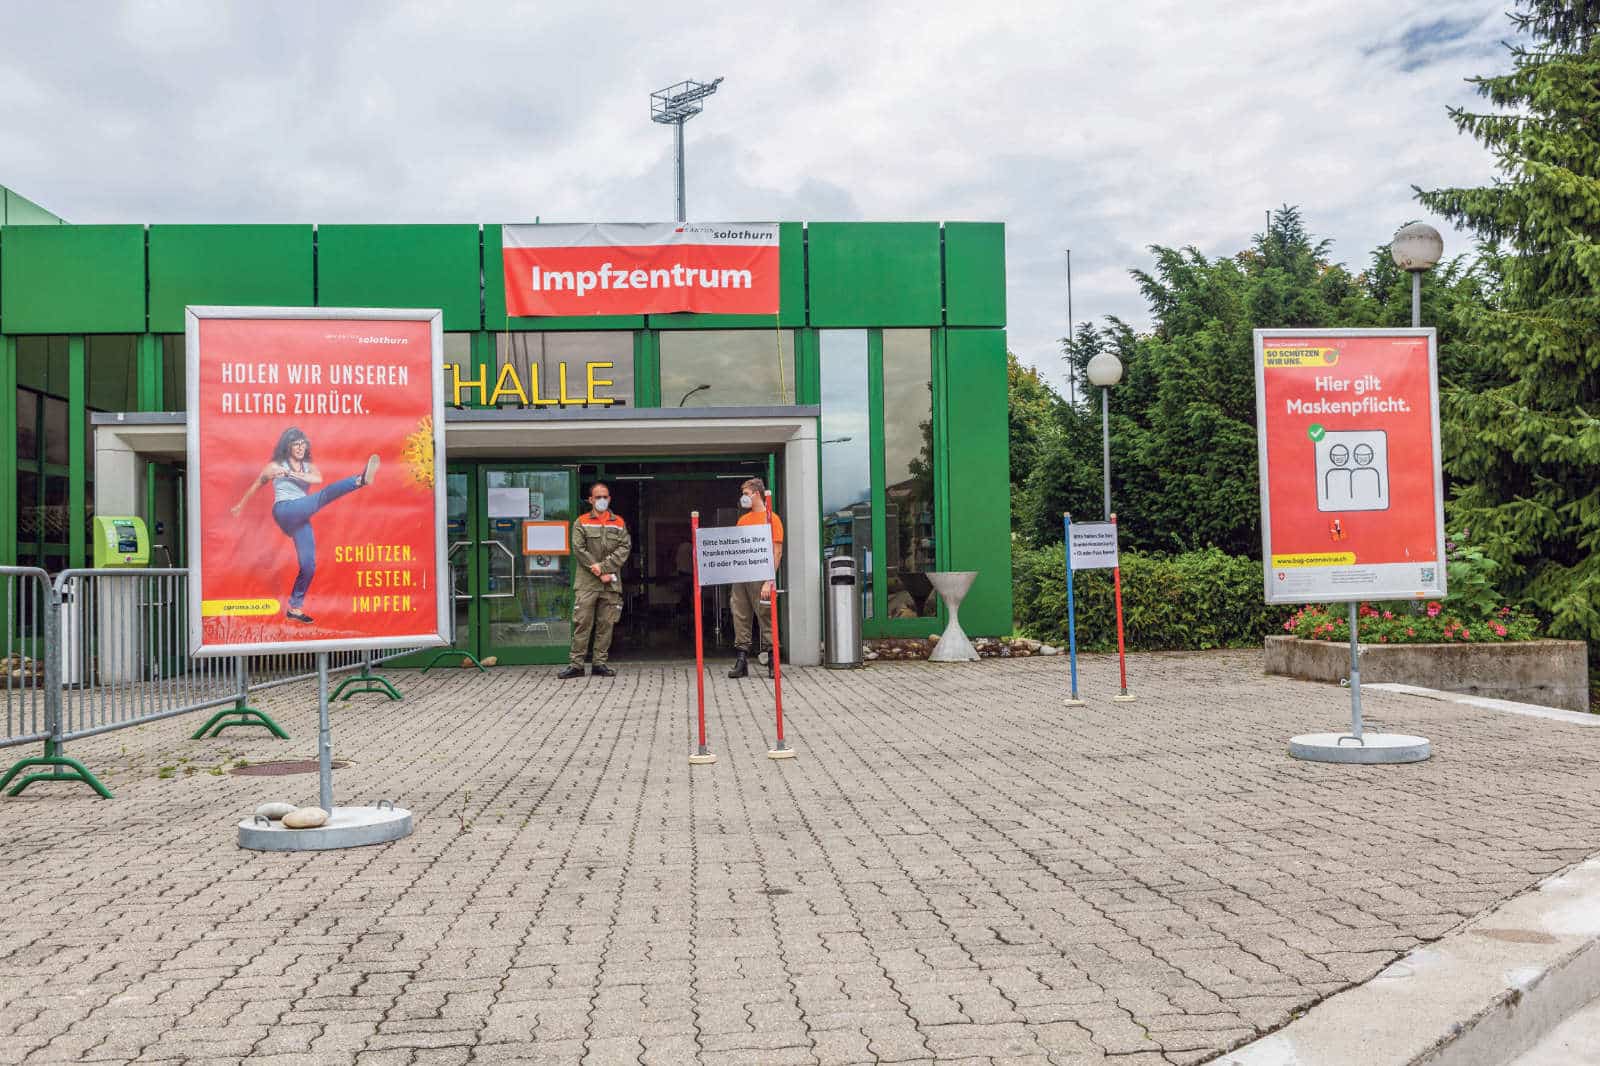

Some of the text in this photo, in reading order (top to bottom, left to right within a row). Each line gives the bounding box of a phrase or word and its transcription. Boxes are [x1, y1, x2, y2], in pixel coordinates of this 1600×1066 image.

[713, 230, 773, 240] solothurn
[531, 262, 753, 297] Impfzentrum
[358, 335, 409, 345] solothurn
[1266, 350, 1277, 358] SO
[1267, 358, 1283, 366] WIR
[221, 363, 409, 386] HOLEN WIR UNSEREN
[442, 361, 614, 406] HALLE
[1315, 375, 1382, 396] Hier gilt
[222, 390, 370, 415] ALLTAG ZURÜCK.
[1286, 397, 1411, 416] Maskenpflicht.
[335, 542, 417, 563] SCHÜTZEN.
[356, 570, 417, 588] TESTEN.
[352, 595, 417, 613] IMPFEN.
